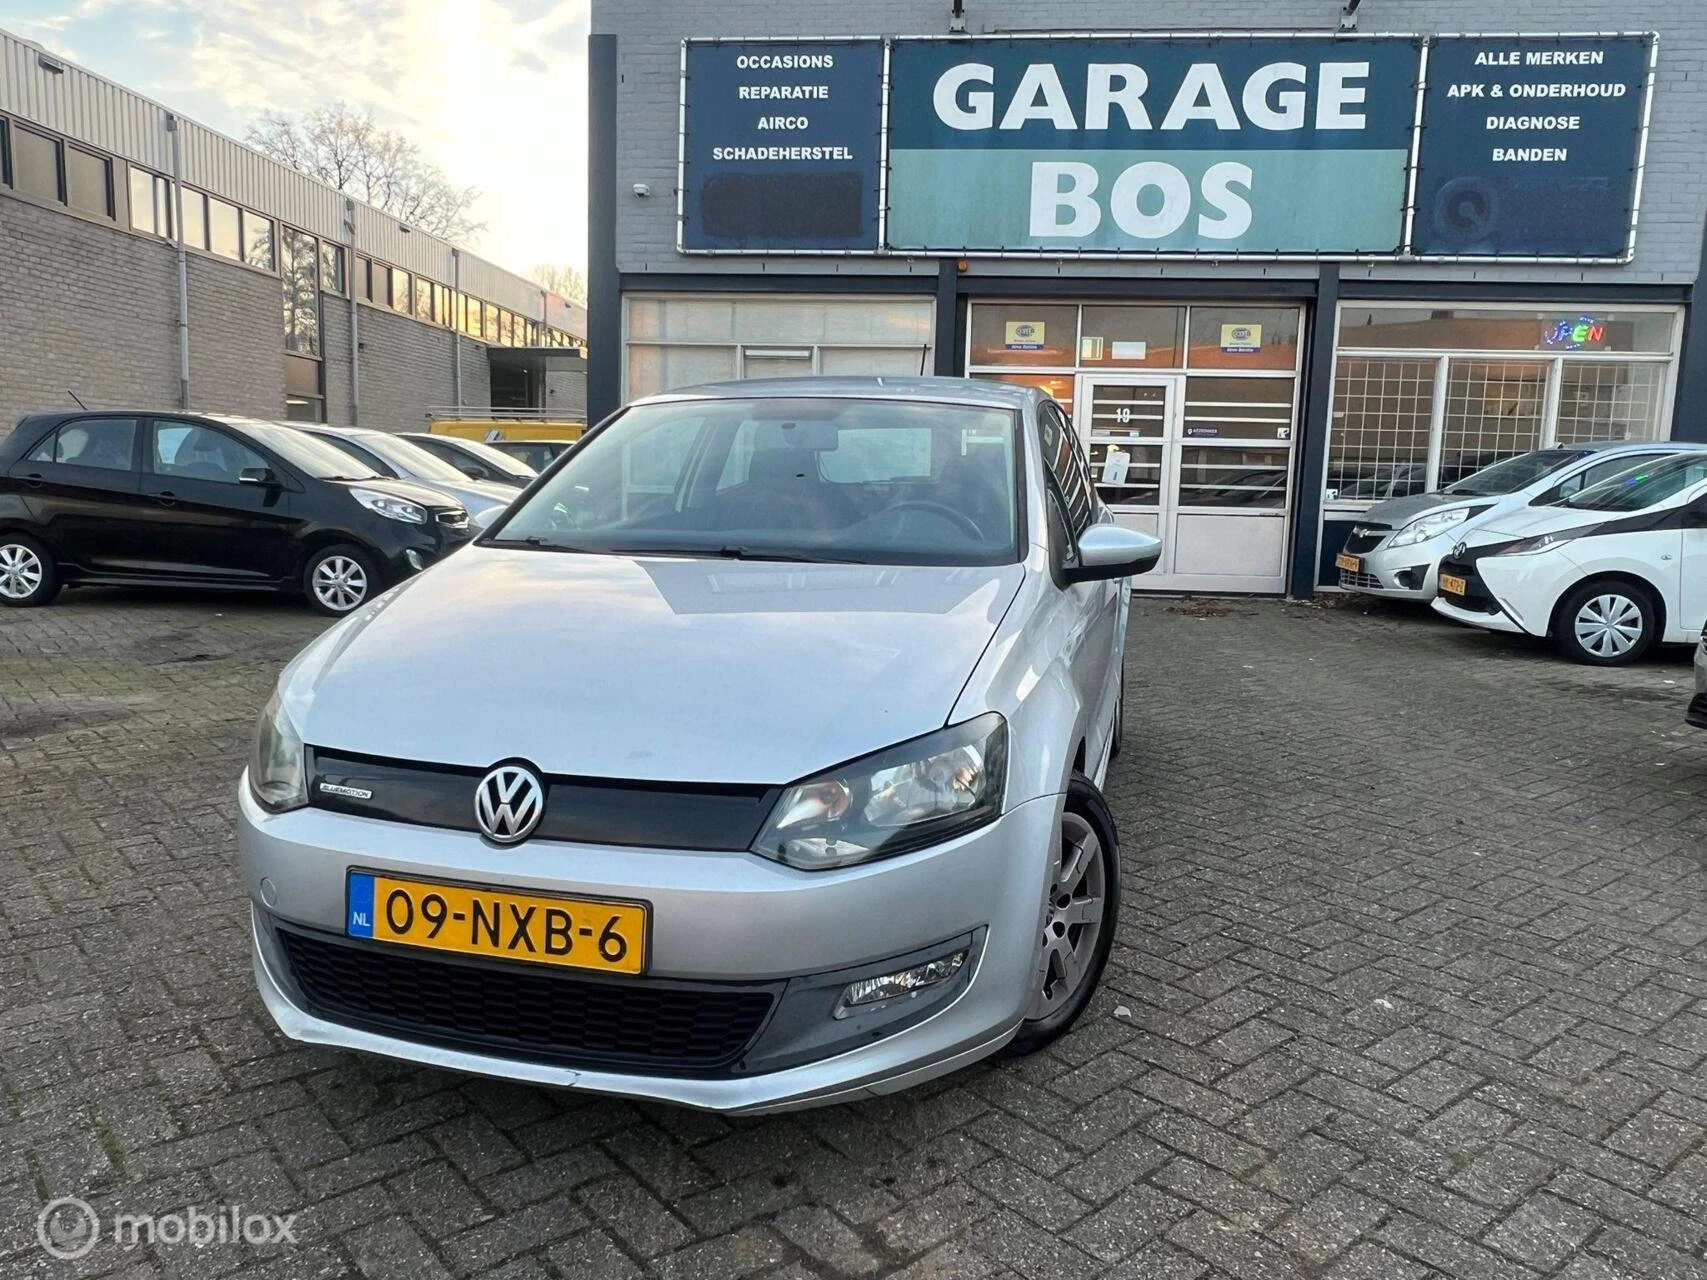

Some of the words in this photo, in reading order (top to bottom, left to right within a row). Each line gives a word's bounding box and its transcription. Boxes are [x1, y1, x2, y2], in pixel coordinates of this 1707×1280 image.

[736, 55, 834, 69] OCCASIONS
[1474, 51, 1521, 66] ALLE
[1525, 51, 1604, 65] MERKEN
[738, 86, 829, 99] REPARATIE
[933, 62, 1370, 130] GARAGE
[1447, 84, 1485, 98] APK
[1490, 84, 1504, 98] &
[1509, 83, 1627, 98] ONDERHOUD
[757, 116, 809, 130] AIRCO
[1486, 116, 1581, 130] DIAGNOSE
[712, 147, 853, 160] SCHADEHERSTEL
[1492, 148, 1568, 162] BANDEN
[1029, 161, 1253, 239] BOS
[1116, 407, 1131, 424] 19
[352, 911, 371, 927] NL
[386, 888, 628, 963] 09-NXB-6
